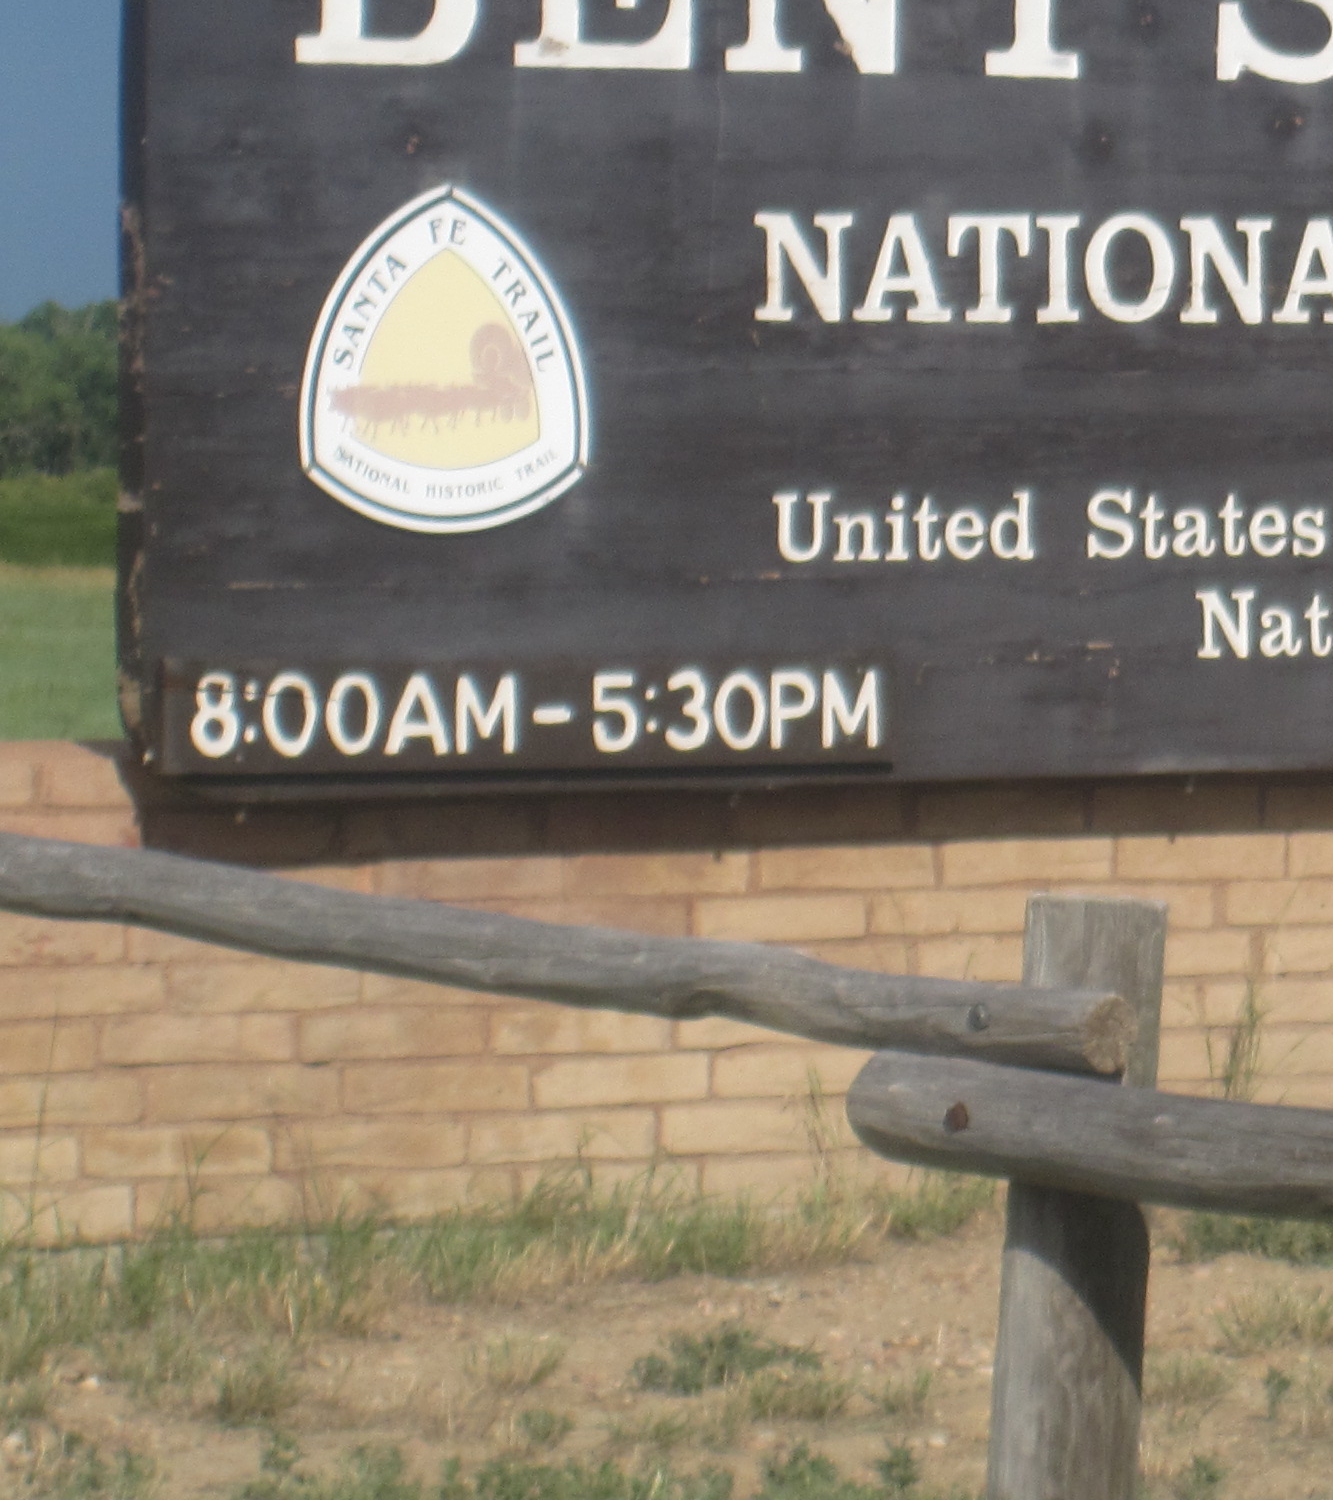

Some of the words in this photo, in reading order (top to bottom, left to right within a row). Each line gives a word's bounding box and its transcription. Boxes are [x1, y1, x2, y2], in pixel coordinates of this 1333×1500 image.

[333, 254, 409, 370] SANTA
[429, 217, 468, 246] FE
[490, 257, 557, 373] TRAIL
[773, 490, 1035, 562] United
[1088, 489, 1326, 559] States
